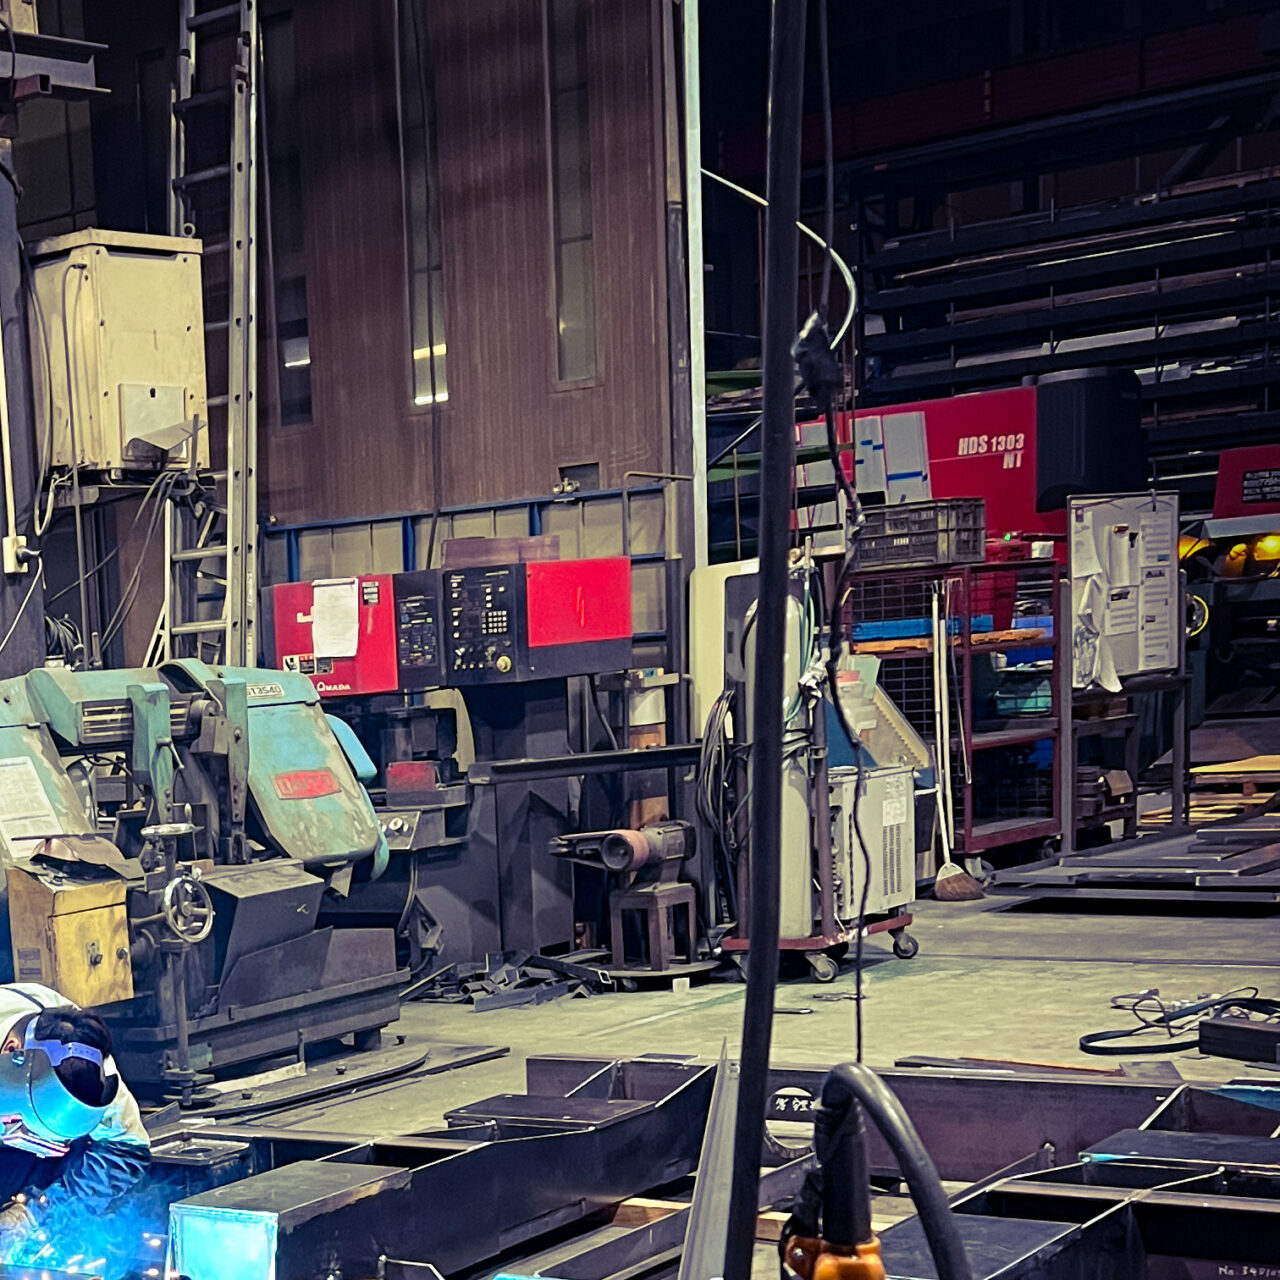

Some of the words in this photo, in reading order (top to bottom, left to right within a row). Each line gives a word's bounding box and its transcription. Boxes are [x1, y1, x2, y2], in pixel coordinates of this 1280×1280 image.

[958, 434, 988, 456] HDS
[991, 432, 1025, 452] 1303
[1002, 452, 1023, 470] NT
